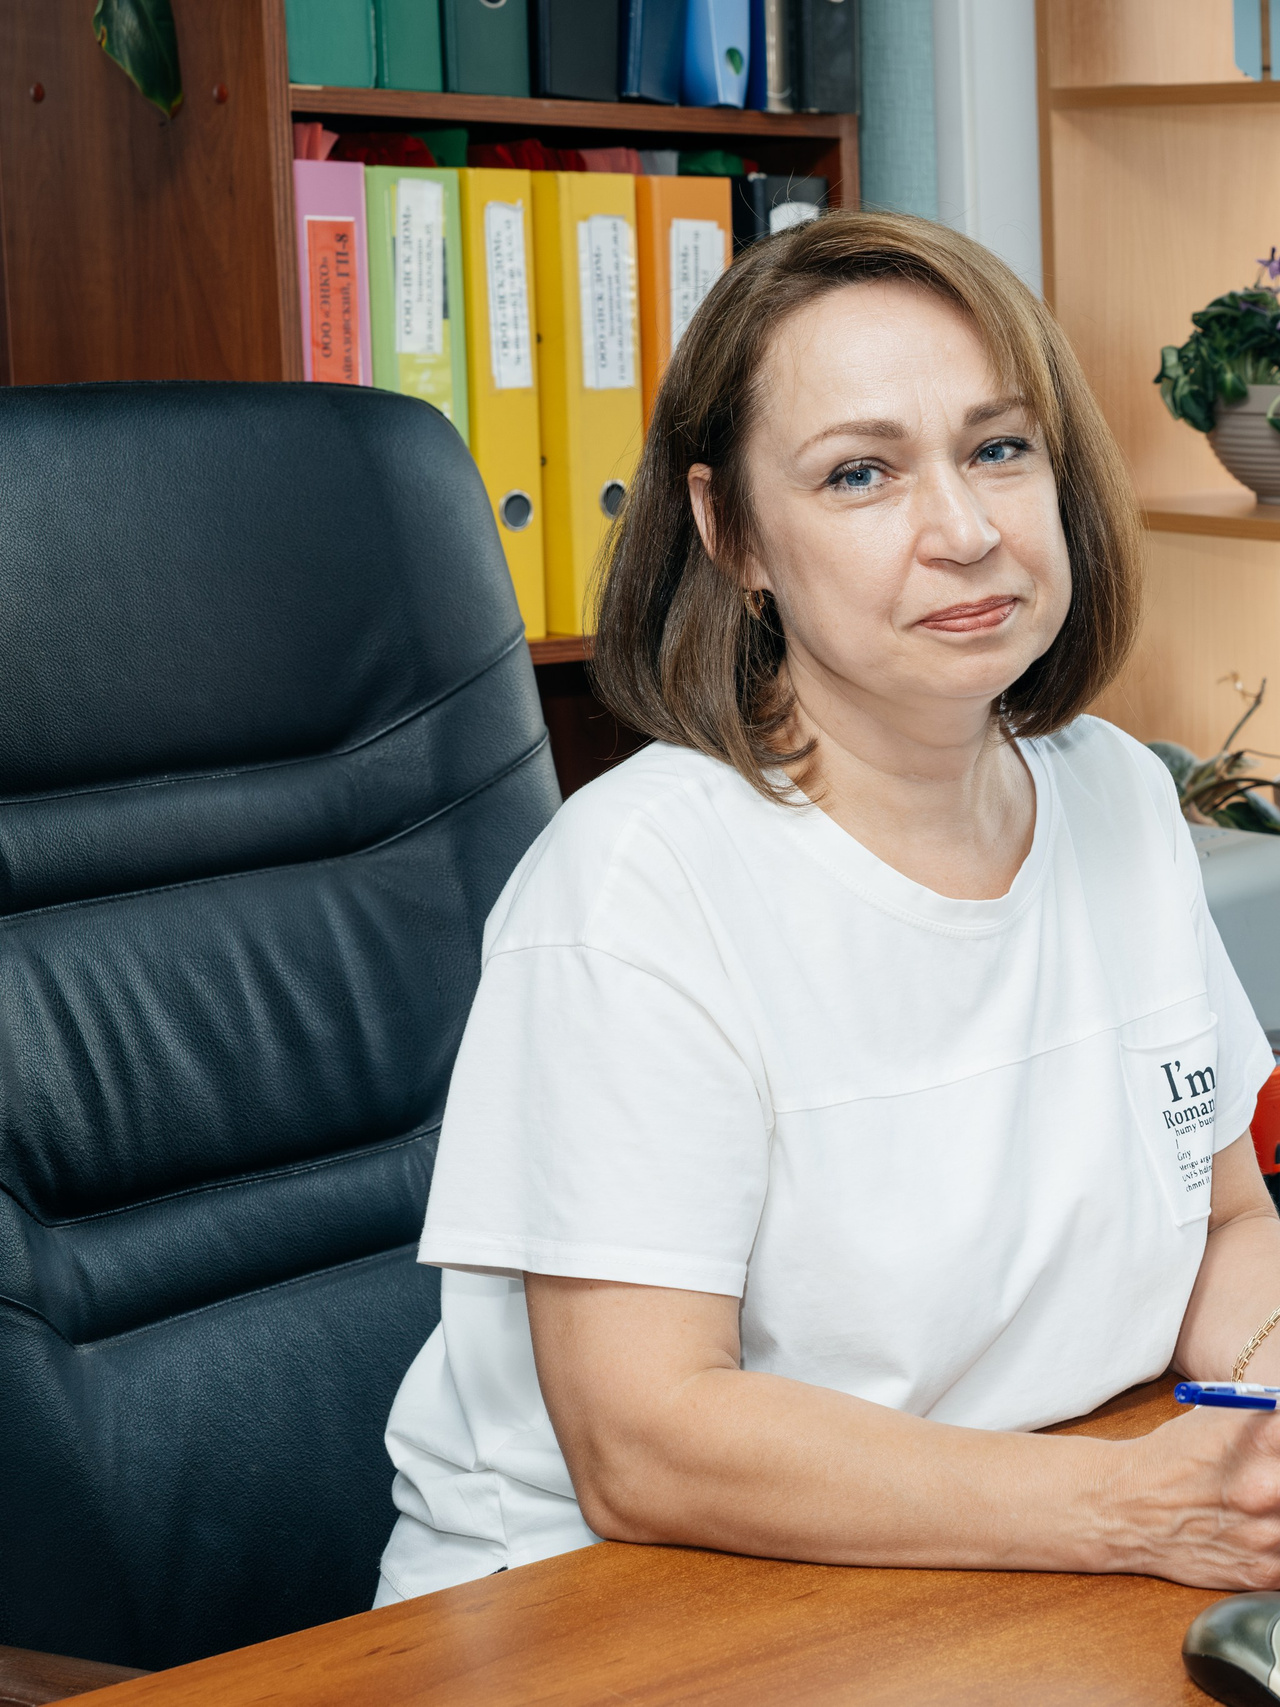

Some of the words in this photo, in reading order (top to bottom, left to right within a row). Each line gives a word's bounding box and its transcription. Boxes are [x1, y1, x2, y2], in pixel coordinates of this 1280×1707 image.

[335, 233, 350, 278] ГП-8
[404, 299, 412, 335] ООО
[320, 322, 332, 358] ООО
